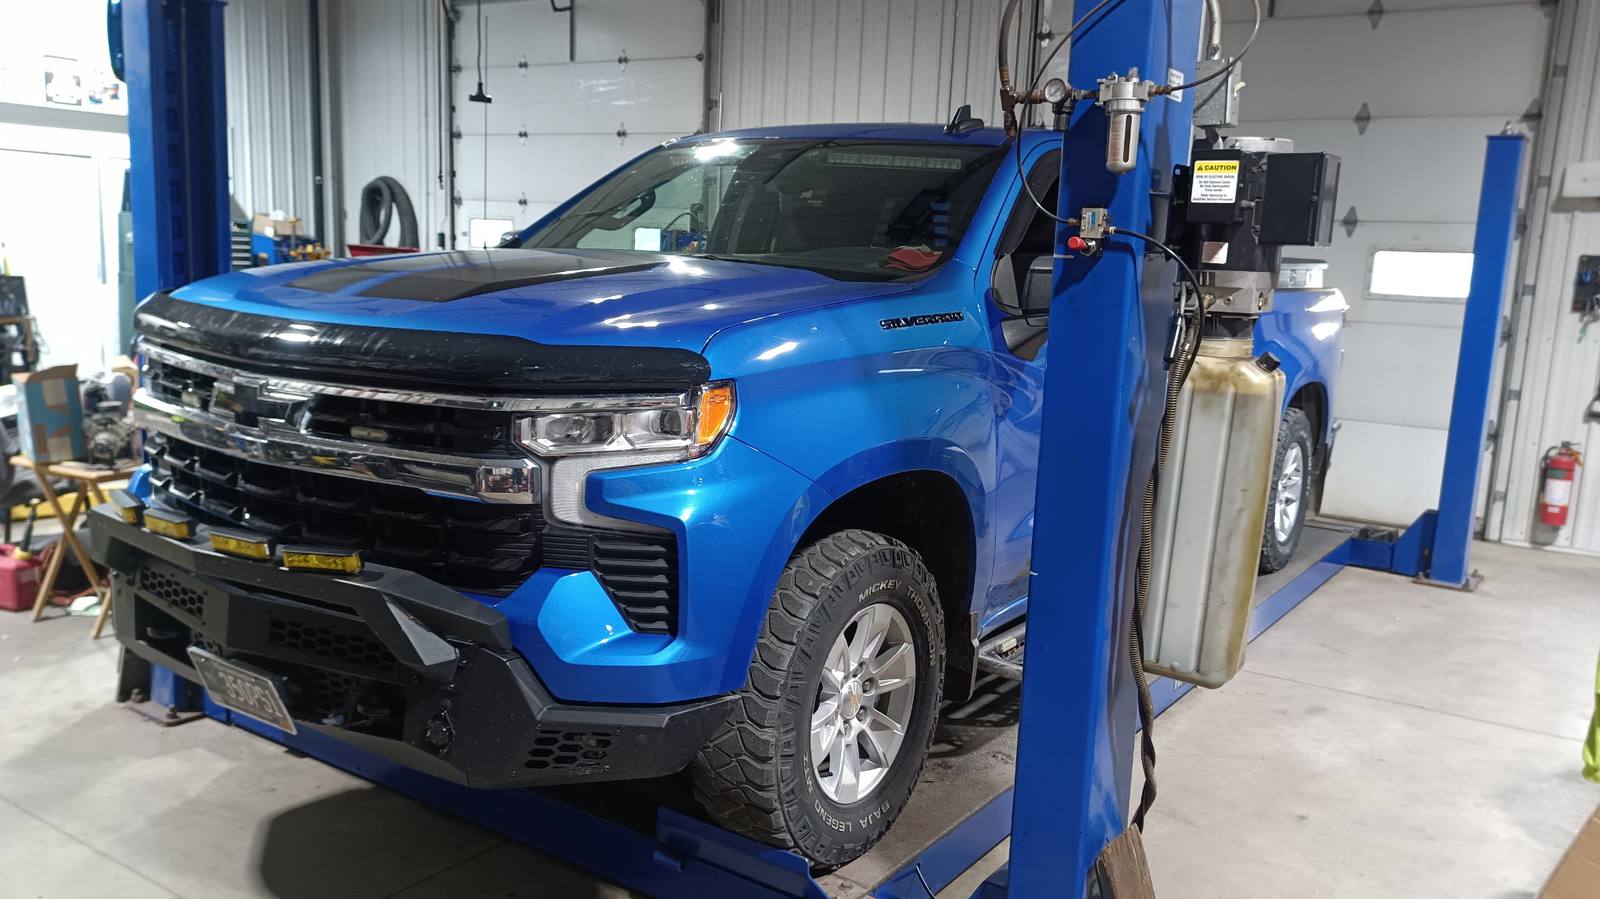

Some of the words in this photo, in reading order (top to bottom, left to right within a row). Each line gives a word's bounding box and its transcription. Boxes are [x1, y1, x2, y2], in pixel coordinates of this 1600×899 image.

[879, 311, 965, 330] SILVERADO
[858, 579, 903, 603] MICKEY
[906, 585, 937, 667] THOMPSON
[814, 799, 852, 832] LEGEND
[859, 799, 890, 829] BAJA
